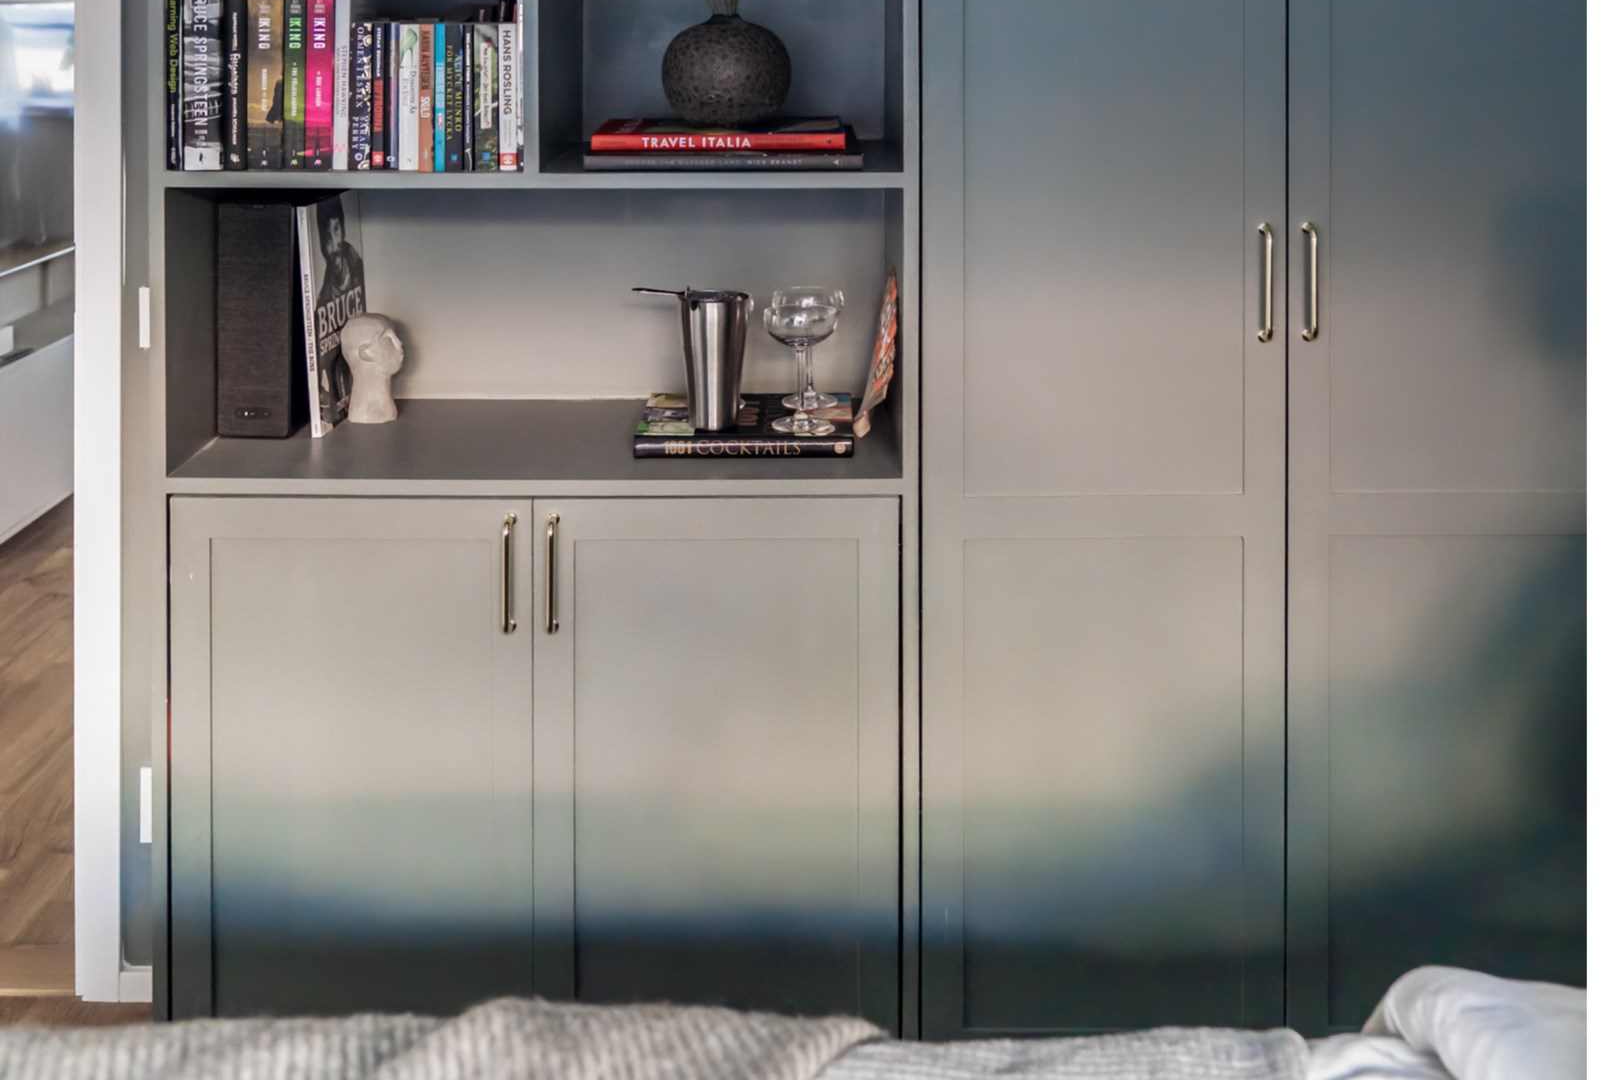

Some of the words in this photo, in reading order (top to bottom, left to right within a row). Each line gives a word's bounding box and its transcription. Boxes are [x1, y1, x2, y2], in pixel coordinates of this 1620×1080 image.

[170, 34, 178, 57] Web
[258, 20, 271, 49] KING
[289, 20, 302, 49] KING
[313, 20, 326, 49] KING
[356, 27, 364, 64] ORMEN
[503, 30, 512, 61] HANS
[446, 45, 454, 63] FÖR
[168, 59, 179, 94] Design
[194, 37, 208, 126] SPRINGSTEEN
[454, 54, 462, 87] ALICE
[356, 75, 364, 108] ESSEX
[503, 65, 512, 115] ROSLING
[454, 91, 462, 132] MUNRO
[642, 137, 696, 148] TRAVEL
[702, 136, 751, 148] ITALIA
[317, 286, 363, 339] BRUCE
[319, 331, 341, 356] SPRIN
[696, 439, 801, 456] COCKTAILS
